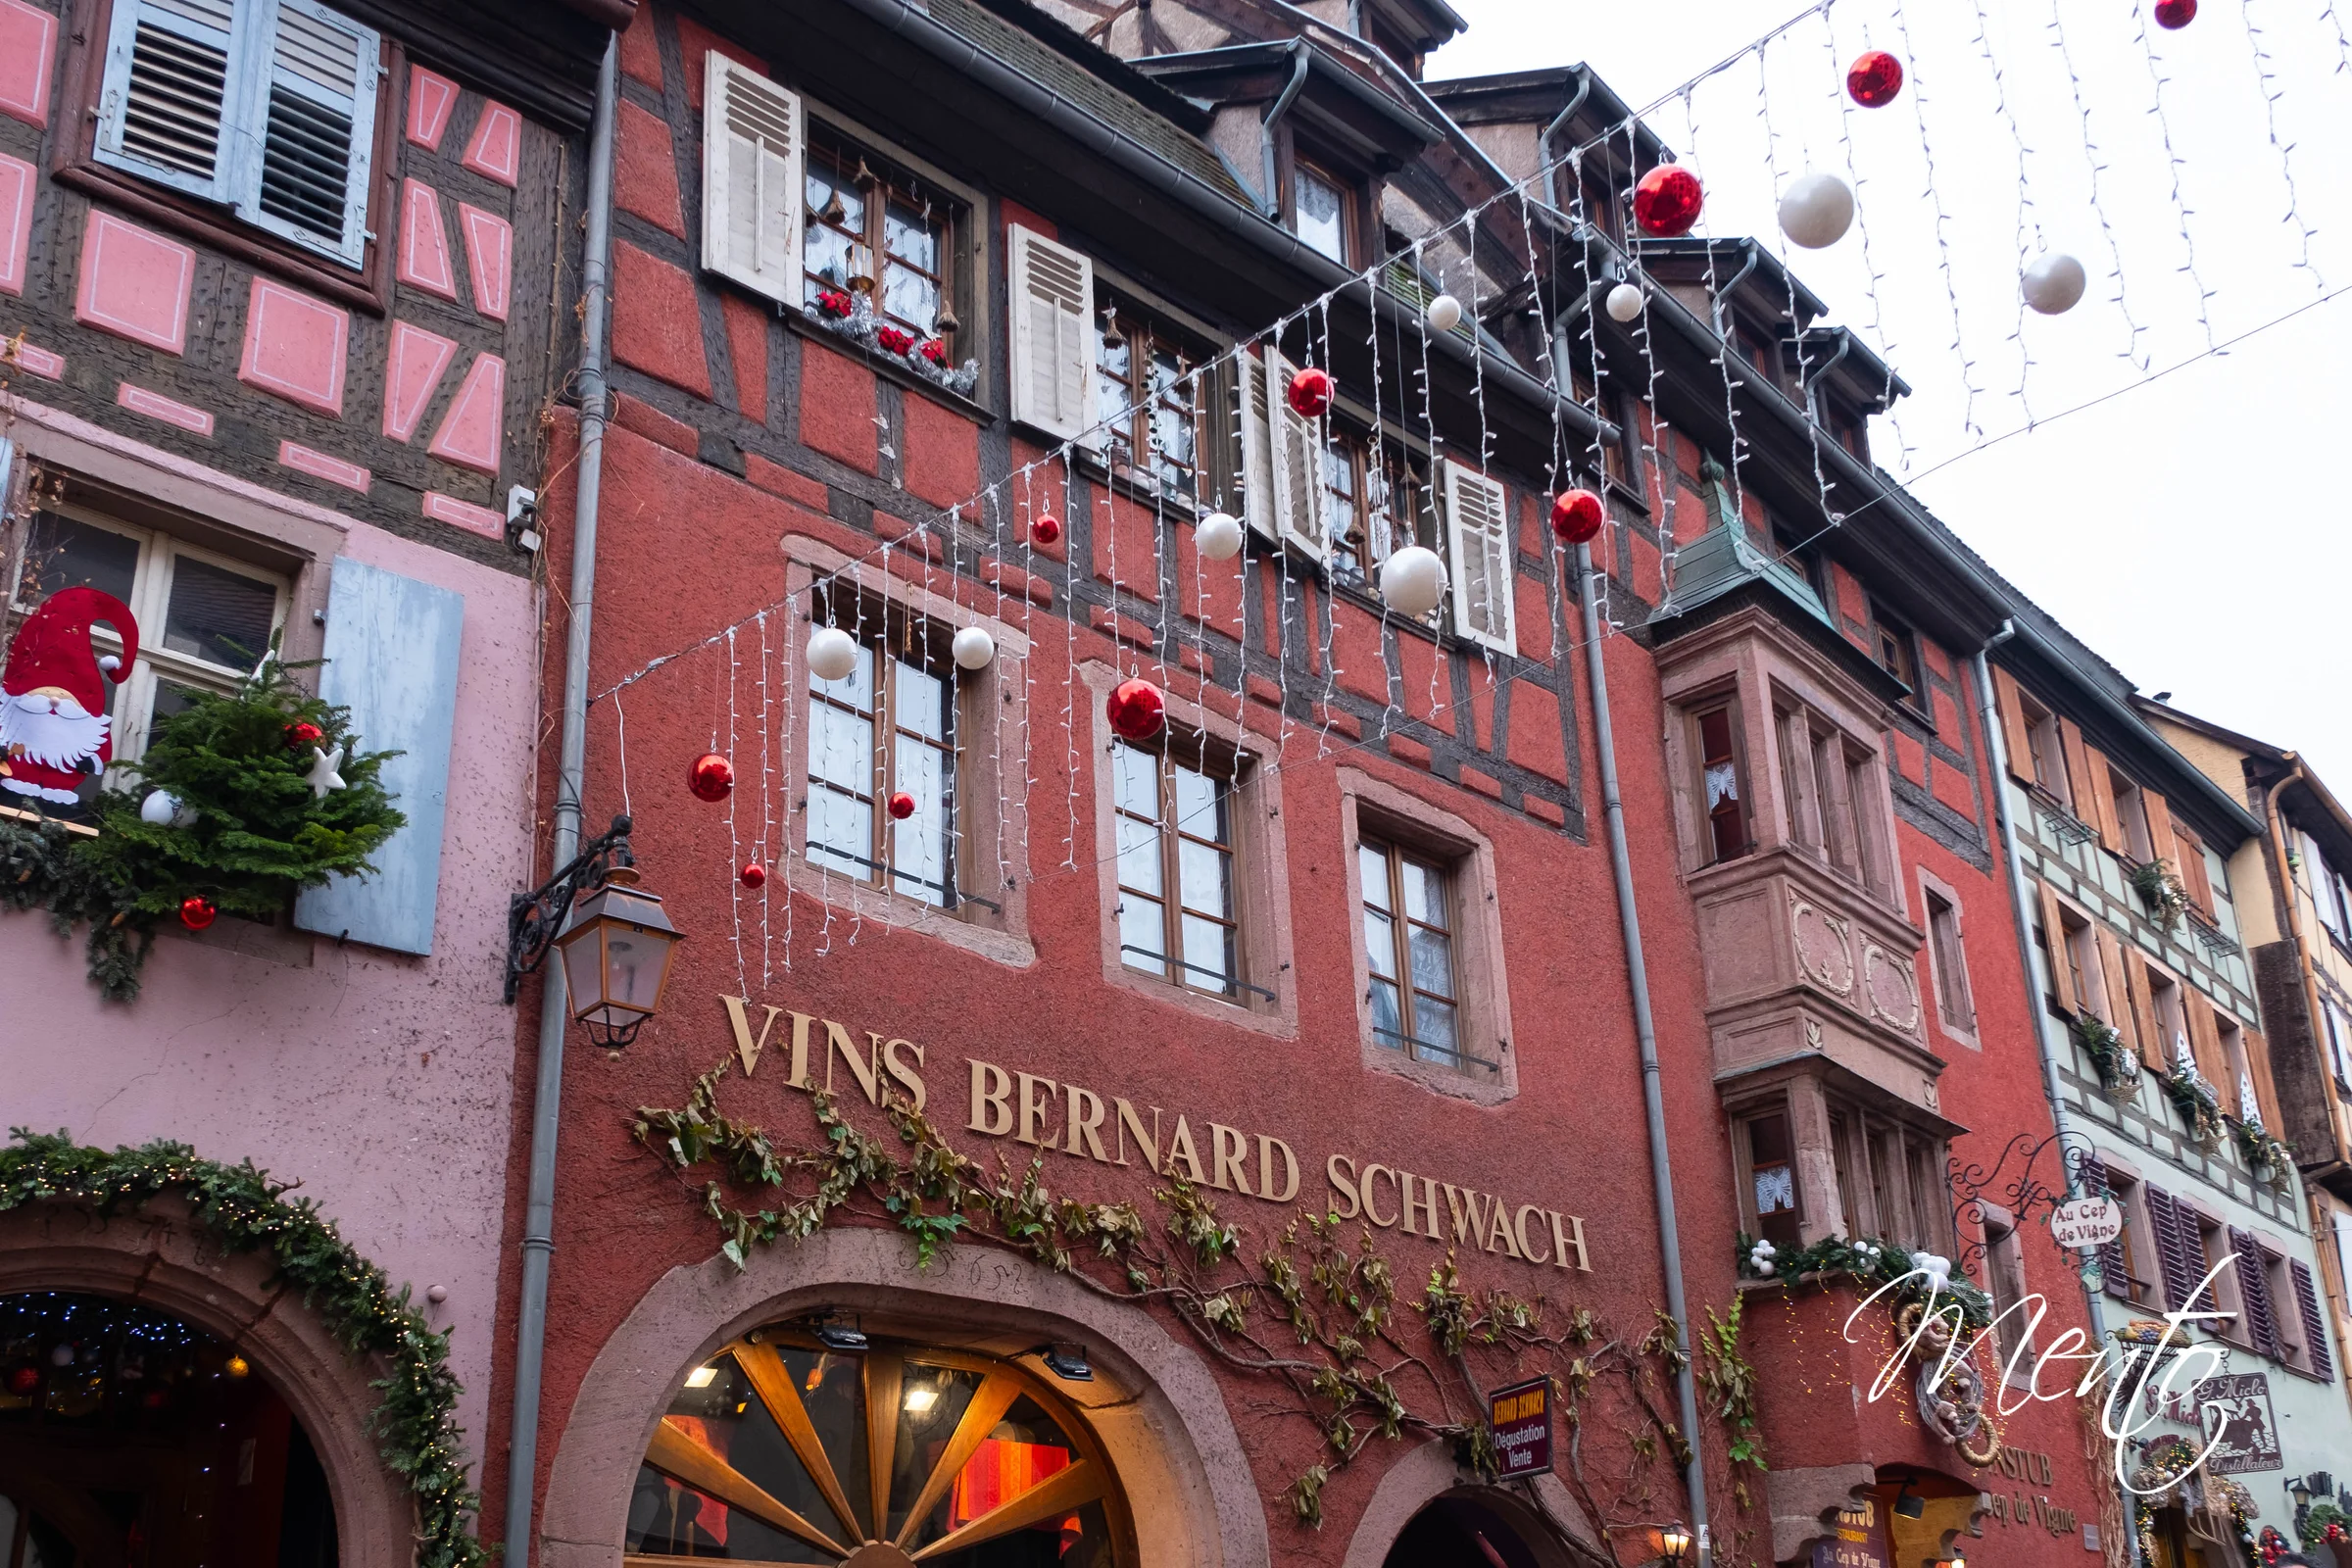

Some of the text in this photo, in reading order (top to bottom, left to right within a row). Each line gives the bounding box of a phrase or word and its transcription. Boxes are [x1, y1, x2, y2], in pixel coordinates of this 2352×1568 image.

[718, 993, 1594, 1273] VINS BERNARD SCHWACH
[2055, 1203, 2108, 1224] Au Cep
[2059, 1224, 2117, 1242] de Vigne
[2216, 1377, 2266, 1399] Miclo
[1494, 1423, 1545, 1450] Dégustation
[1508, 1448, 1533, 1468] Vente
[2209, 1455, 2282, 1472] Distillateur
[1983, 1490, 2077, 1538] ep de Vigne
